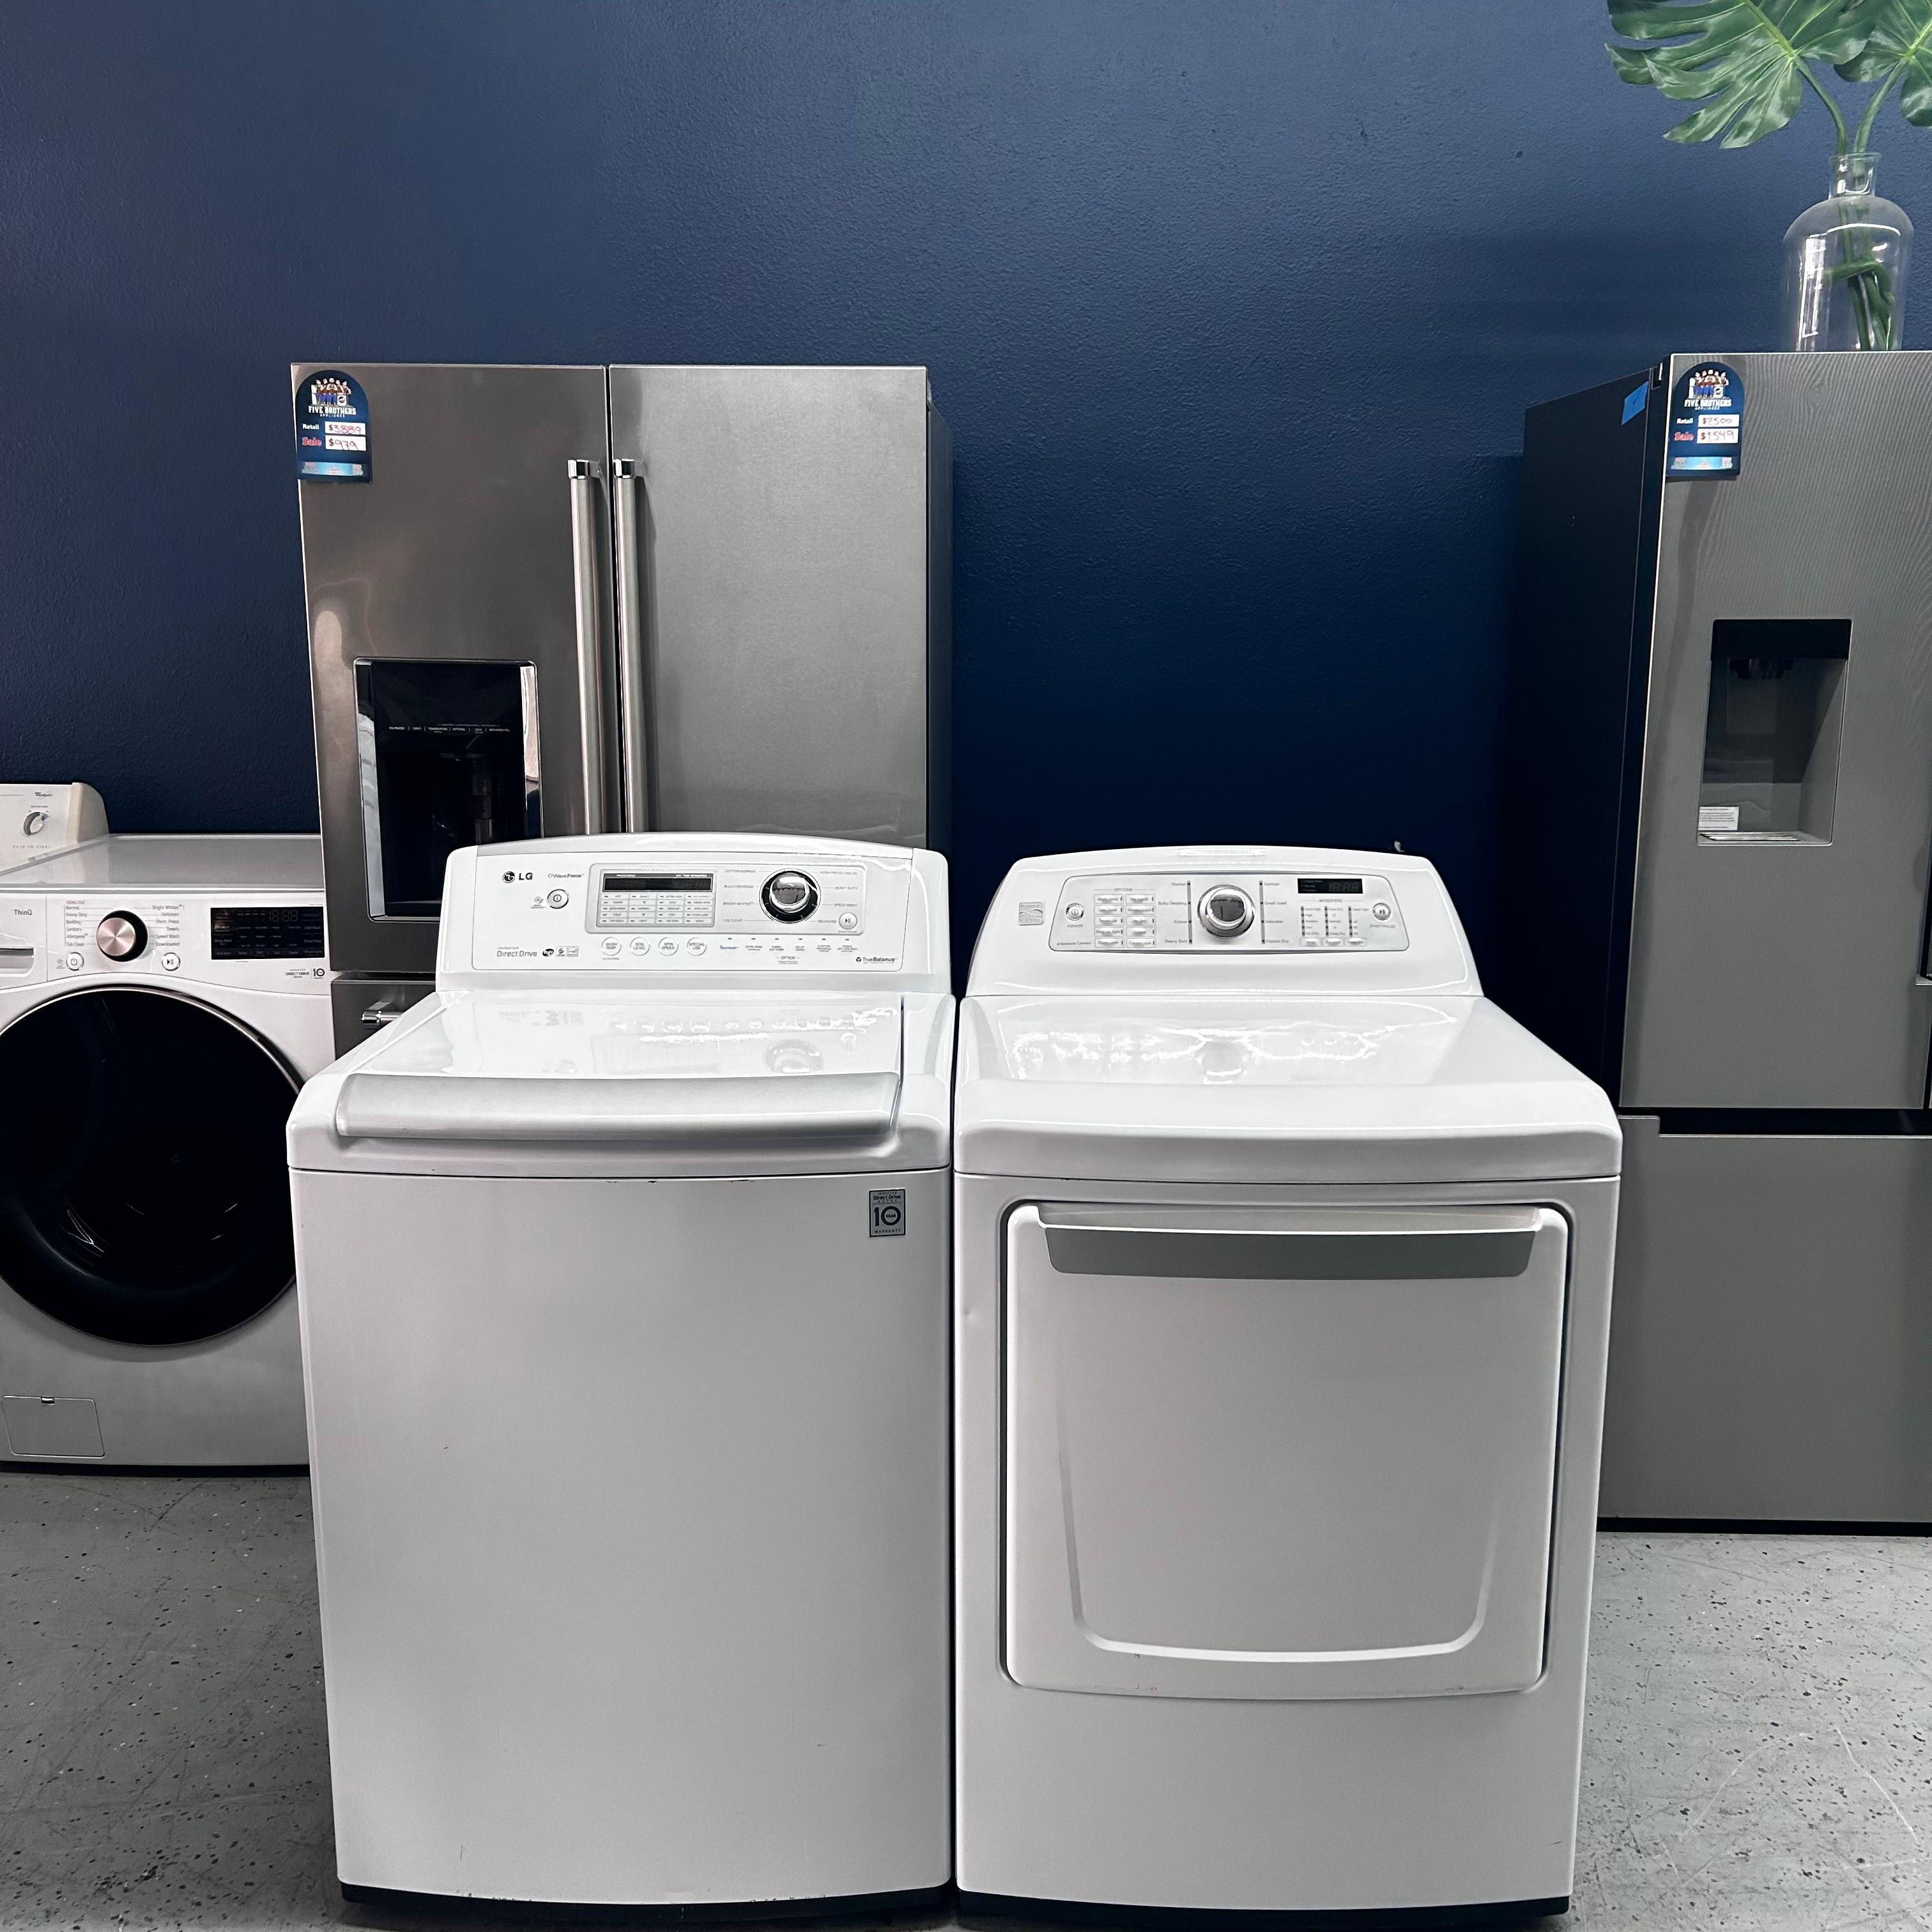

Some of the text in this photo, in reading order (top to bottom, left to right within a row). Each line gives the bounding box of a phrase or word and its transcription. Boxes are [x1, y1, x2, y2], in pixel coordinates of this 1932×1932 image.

[1700, 399, 1732, 407] BROTHERS
[325, 406, 356, 415] BROTHERS
[1703, 417, 1733, 425] $2500
[1675, 431, 1694, 441] Sale
[302, 436, 322, 447] Sale
[519, 872, 533, 880] LG
[873, 1206, 901, 1227] 10
